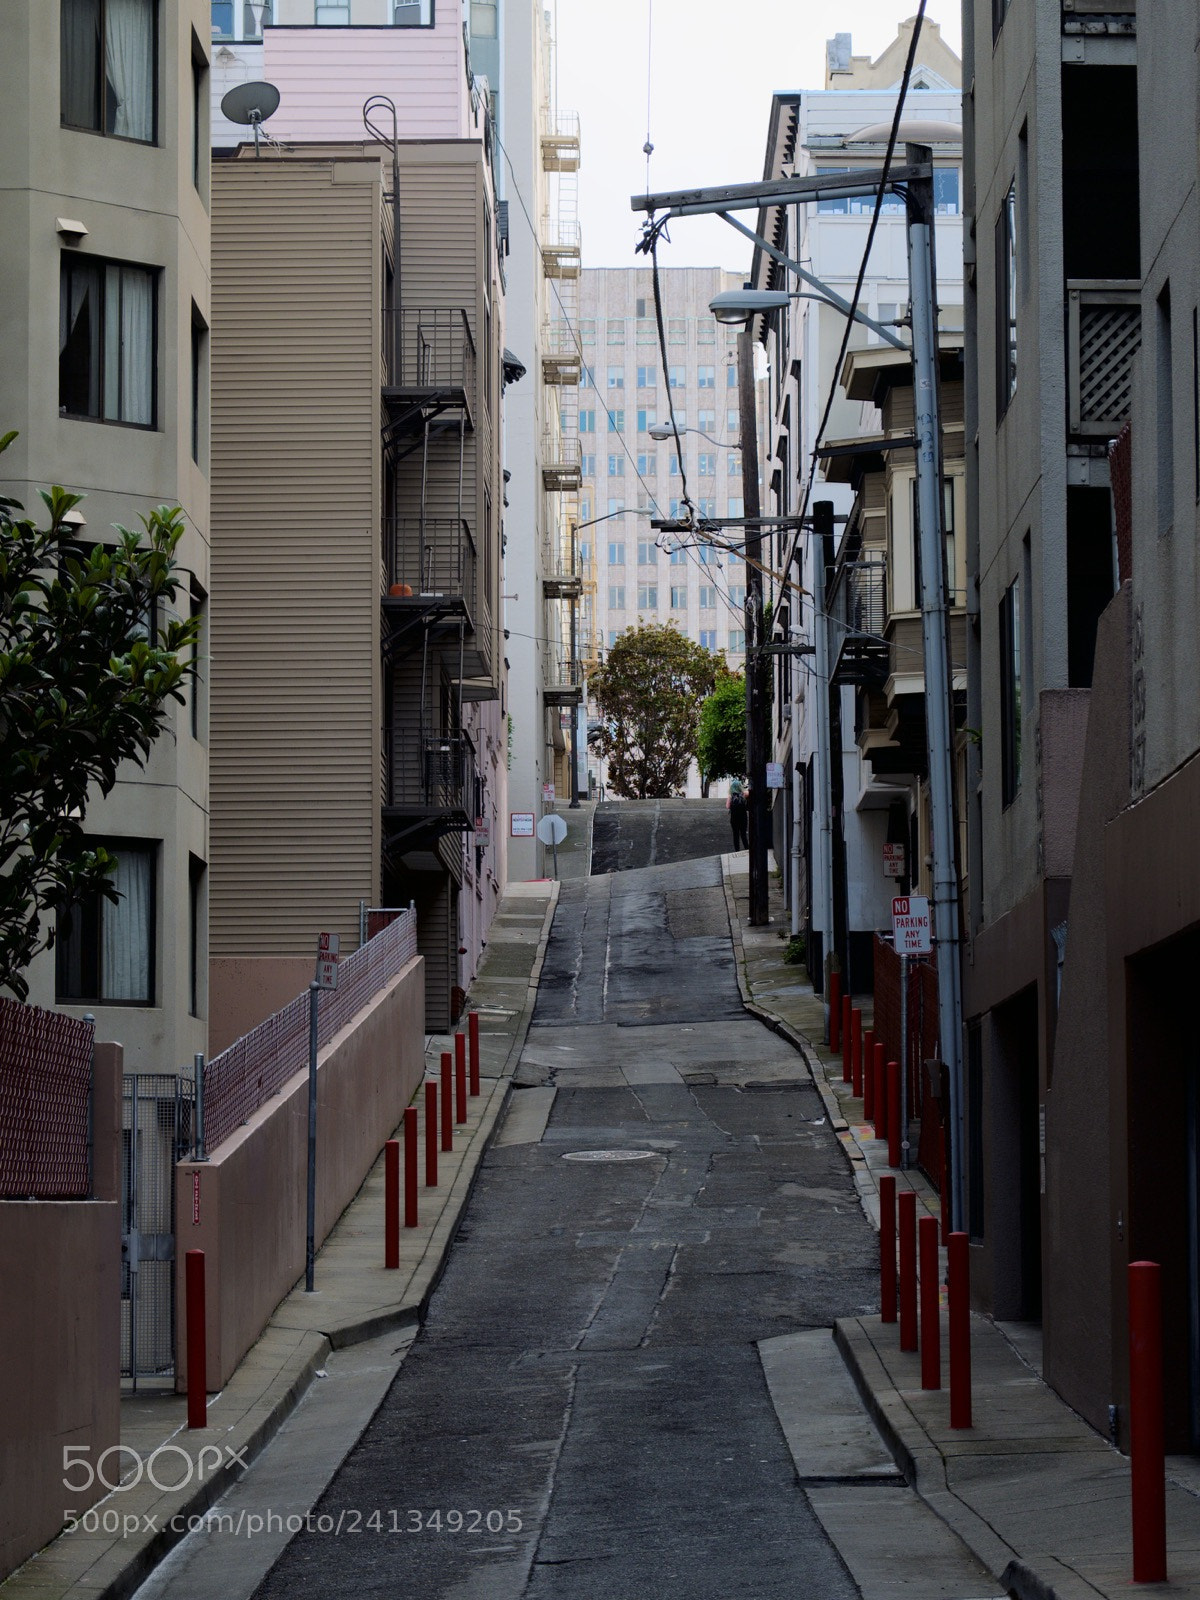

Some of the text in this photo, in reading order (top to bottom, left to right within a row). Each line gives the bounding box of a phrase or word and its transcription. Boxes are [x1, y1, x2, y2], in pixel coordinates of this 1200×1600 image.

[894, 900, 908, 913] NO
[896, 916, 928, 928] PARKING
[905, 930, 920, 939] ANY
[320, 934, 329, 949] NO
[904, 939, 922, 948] TIME
[319, 951, 337, 963] PARKING
[323, 964, 333, 973] ANY
[323, 975, 333, 985] TIME
